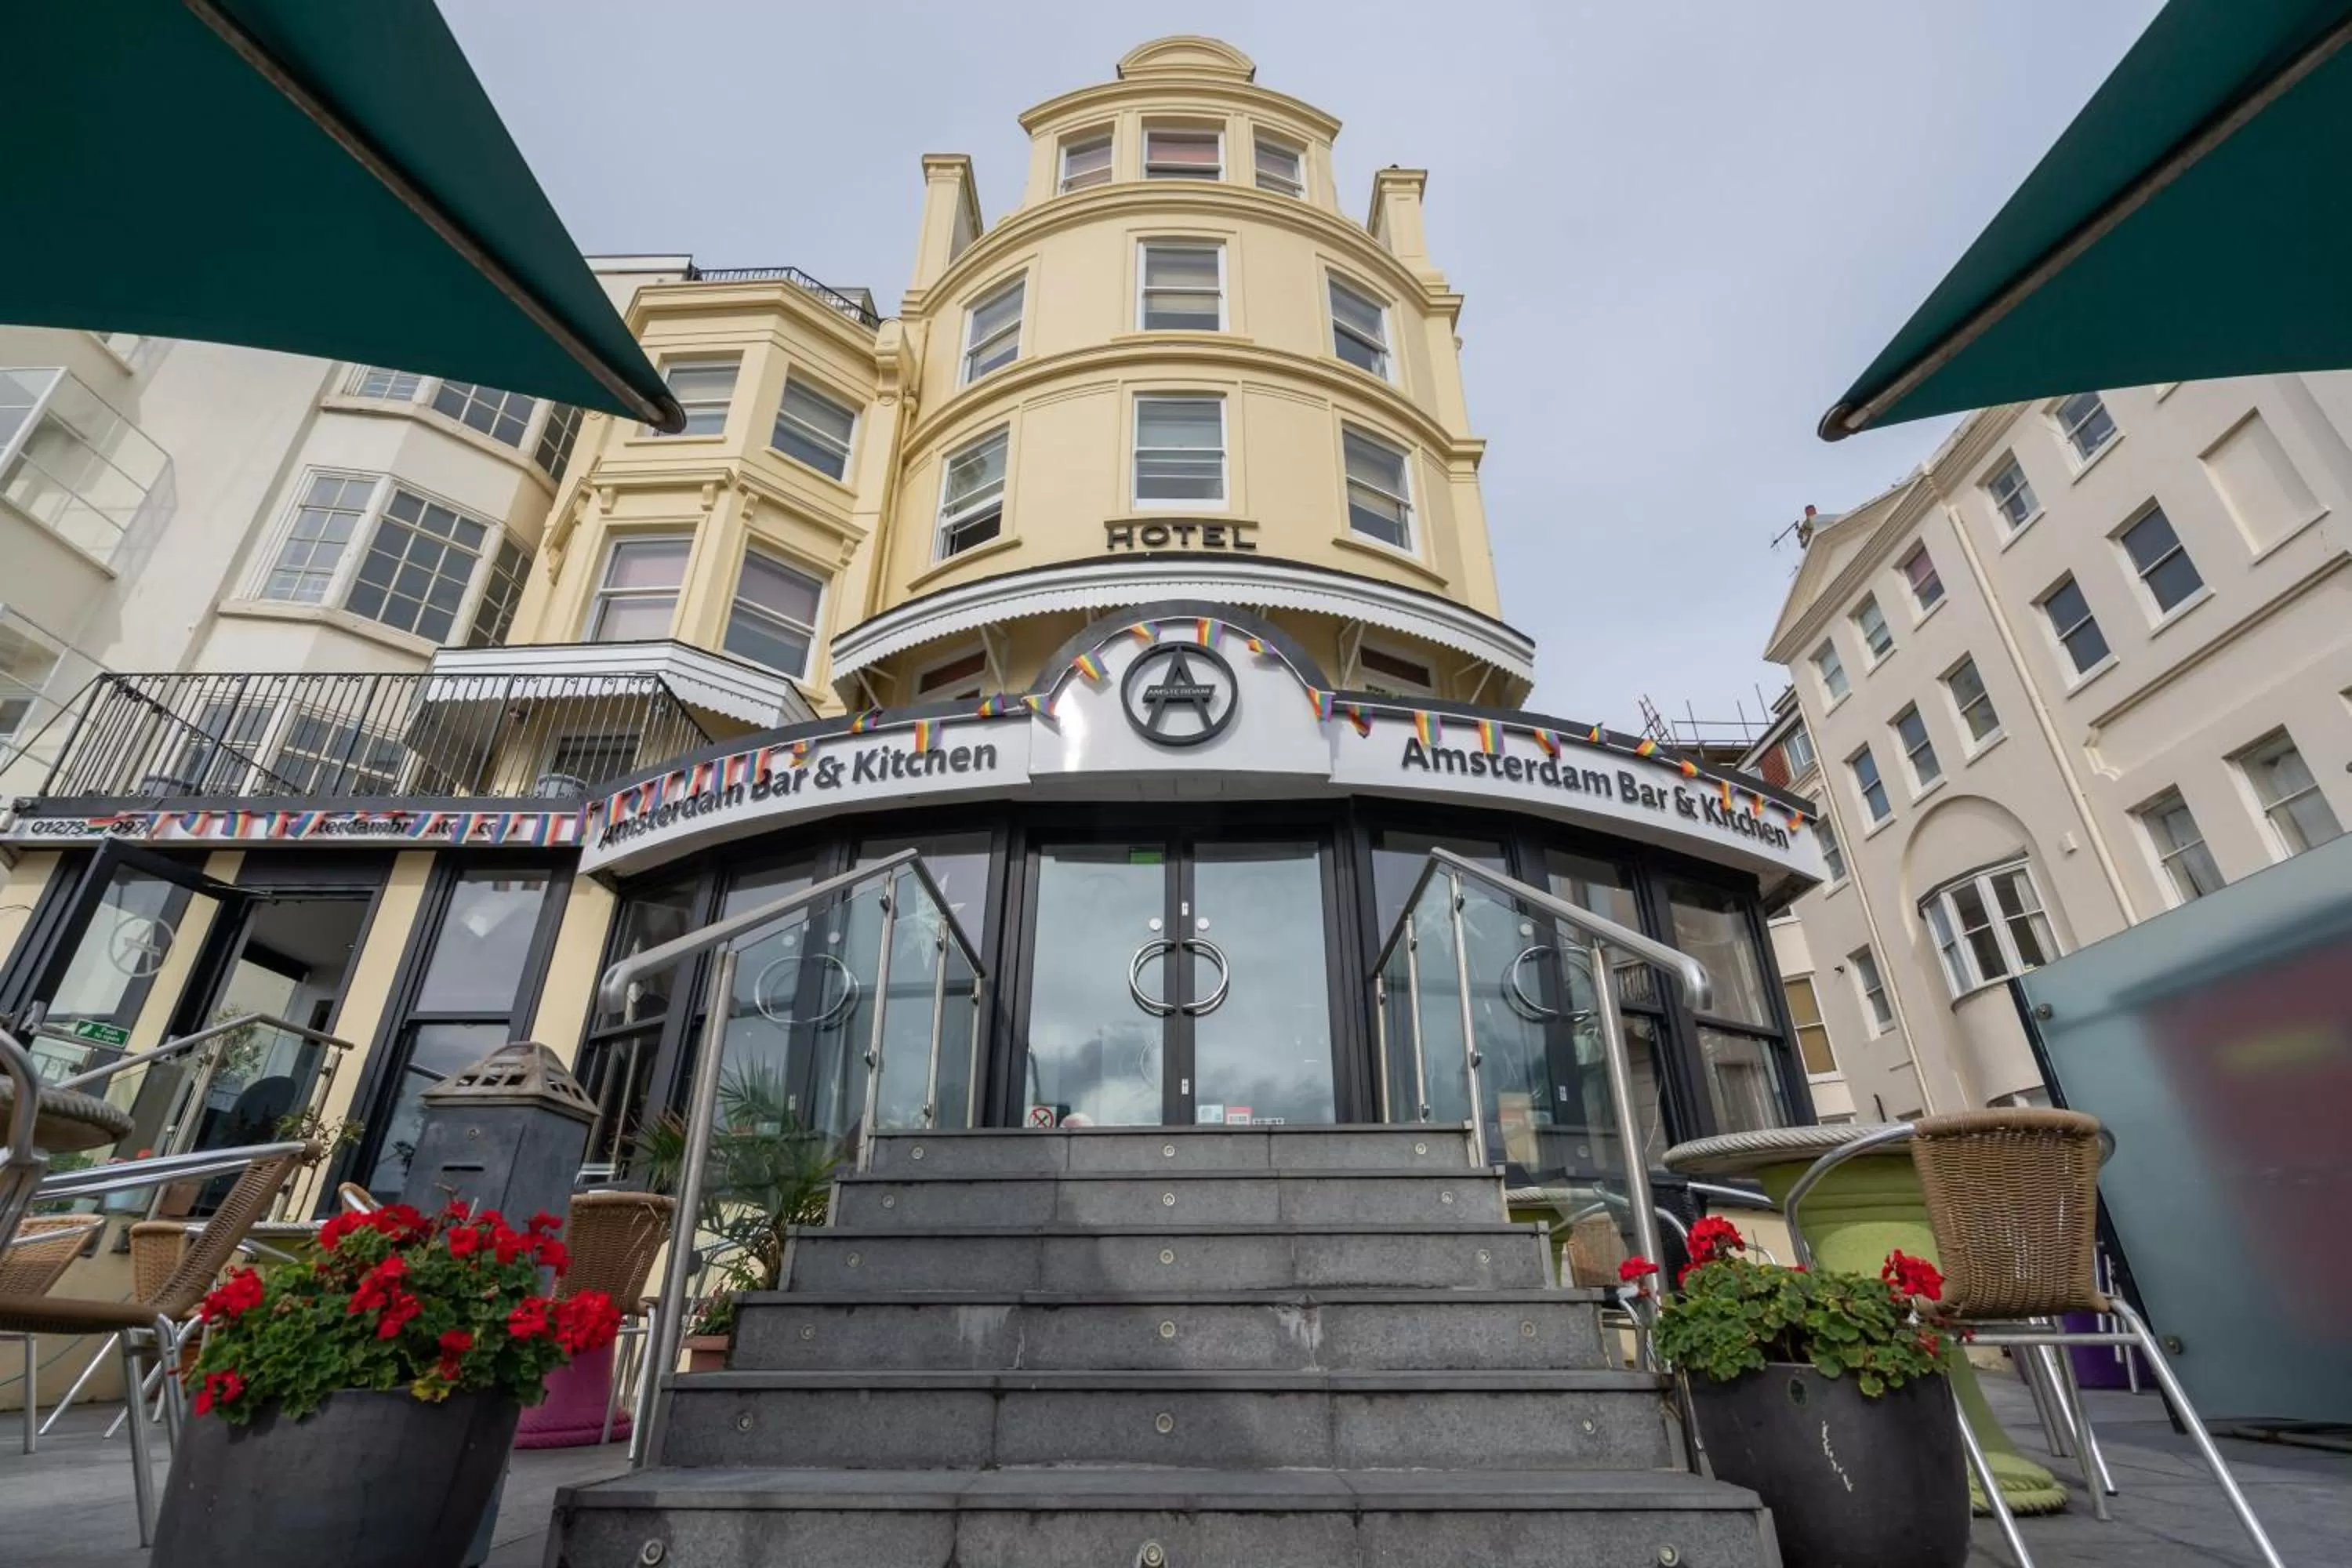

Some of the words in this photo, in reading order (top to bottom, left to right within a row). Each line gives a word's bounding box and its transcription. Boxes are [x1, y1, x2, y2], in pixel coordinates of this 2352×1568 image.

[1107, 524, 1257, 550] HOTEL
[597, 782, 746, 850] Amsterdam
[751, 768, 809, 801] Bar
[814, 755, 845, 788] &
[851, 743, 997, 784] Kitchen
[1401, 737, 1613, 797] Amsterdam
[1617, 769, 1668, 810] Bar
[1674, 786, 1699, 820] &
[1700, 792, 1790, 850] Kitchen
